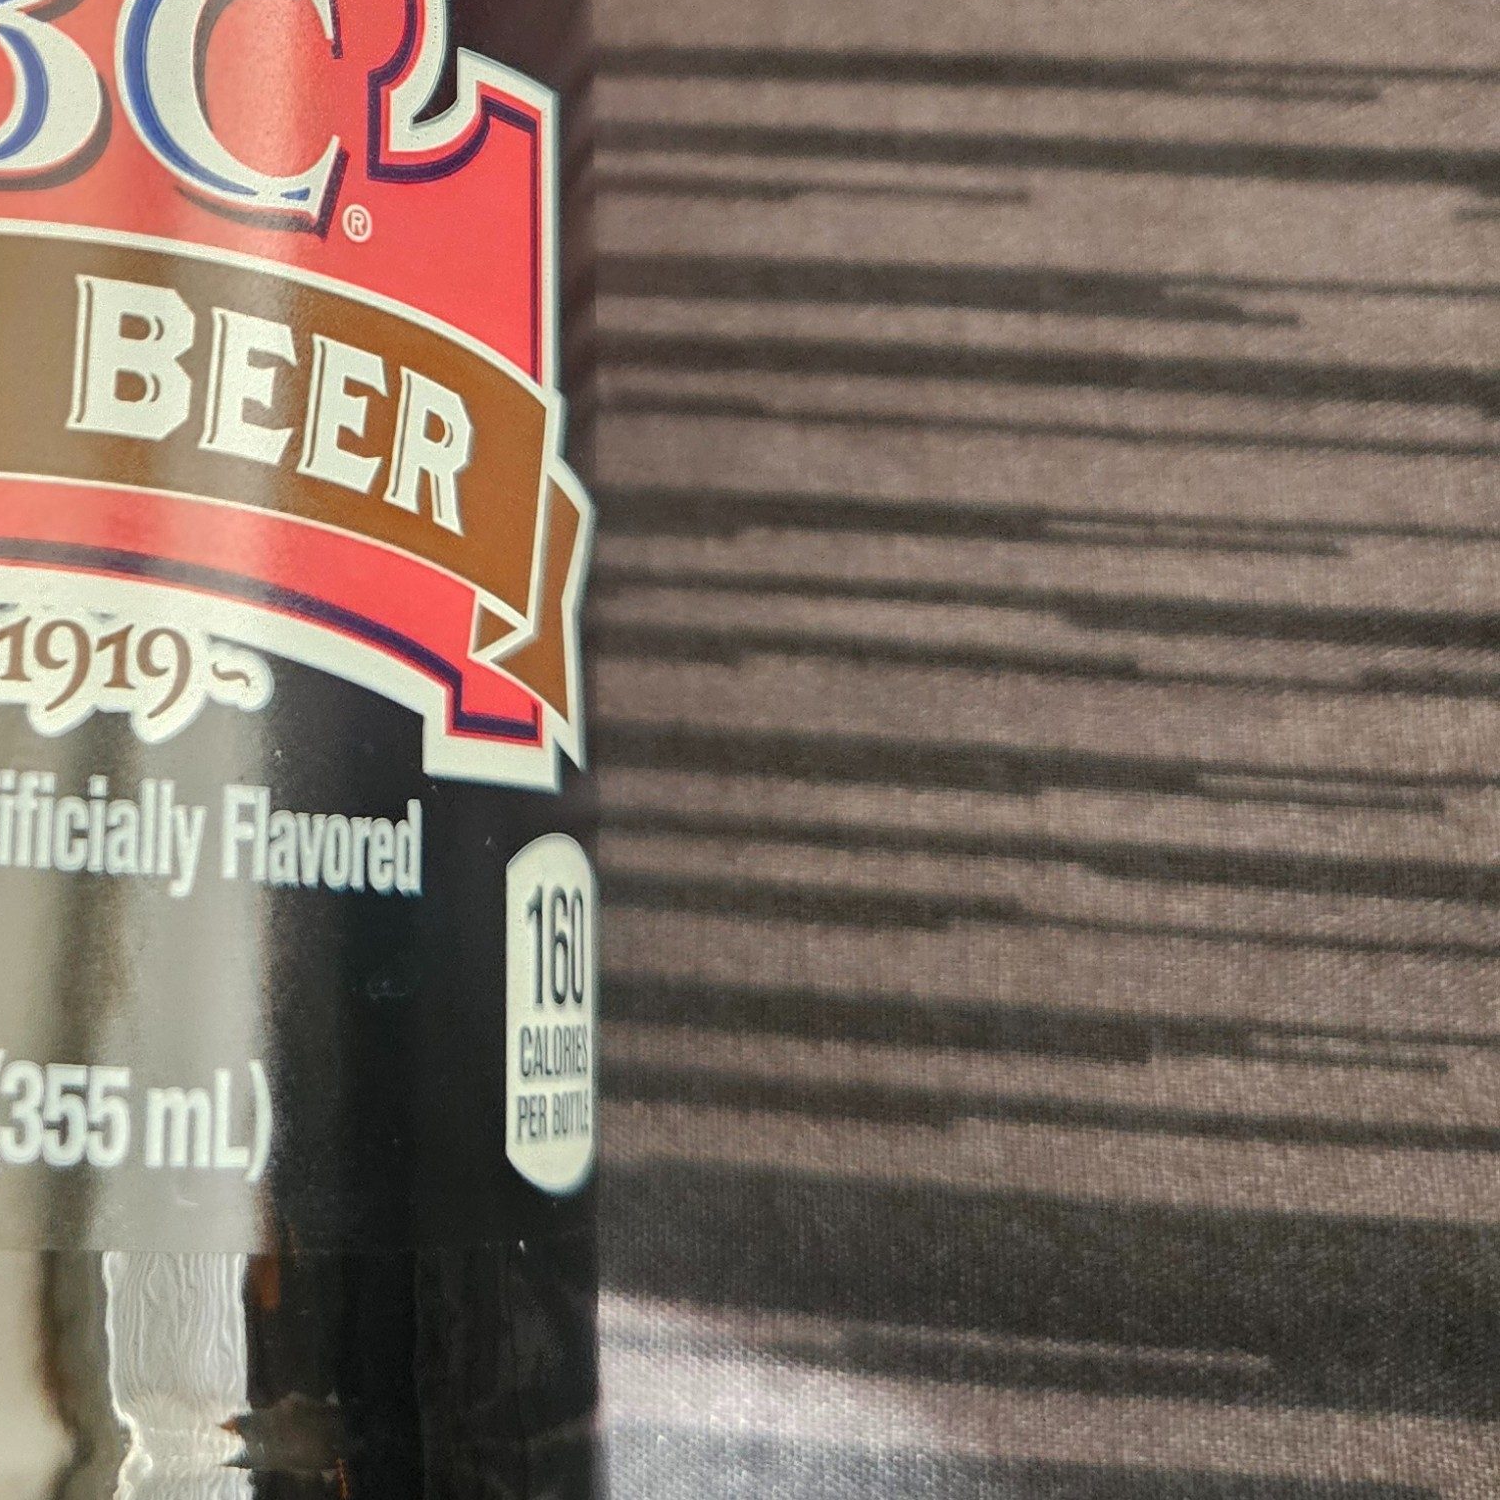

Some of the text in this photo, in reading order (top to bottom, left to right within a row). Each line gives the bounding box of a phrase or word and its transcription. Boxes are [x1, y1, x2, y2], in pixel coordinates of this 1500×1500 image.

[64, 273, 473, 538] BEER
[220, 782, 424, 897] Flavored
[526, 884, 585, 1006] 160
[519, 1024, 590, 1079] CALORIES
[144, 1058, 274, 1184] mL)
[516, 1093, 548, 1144] PER
